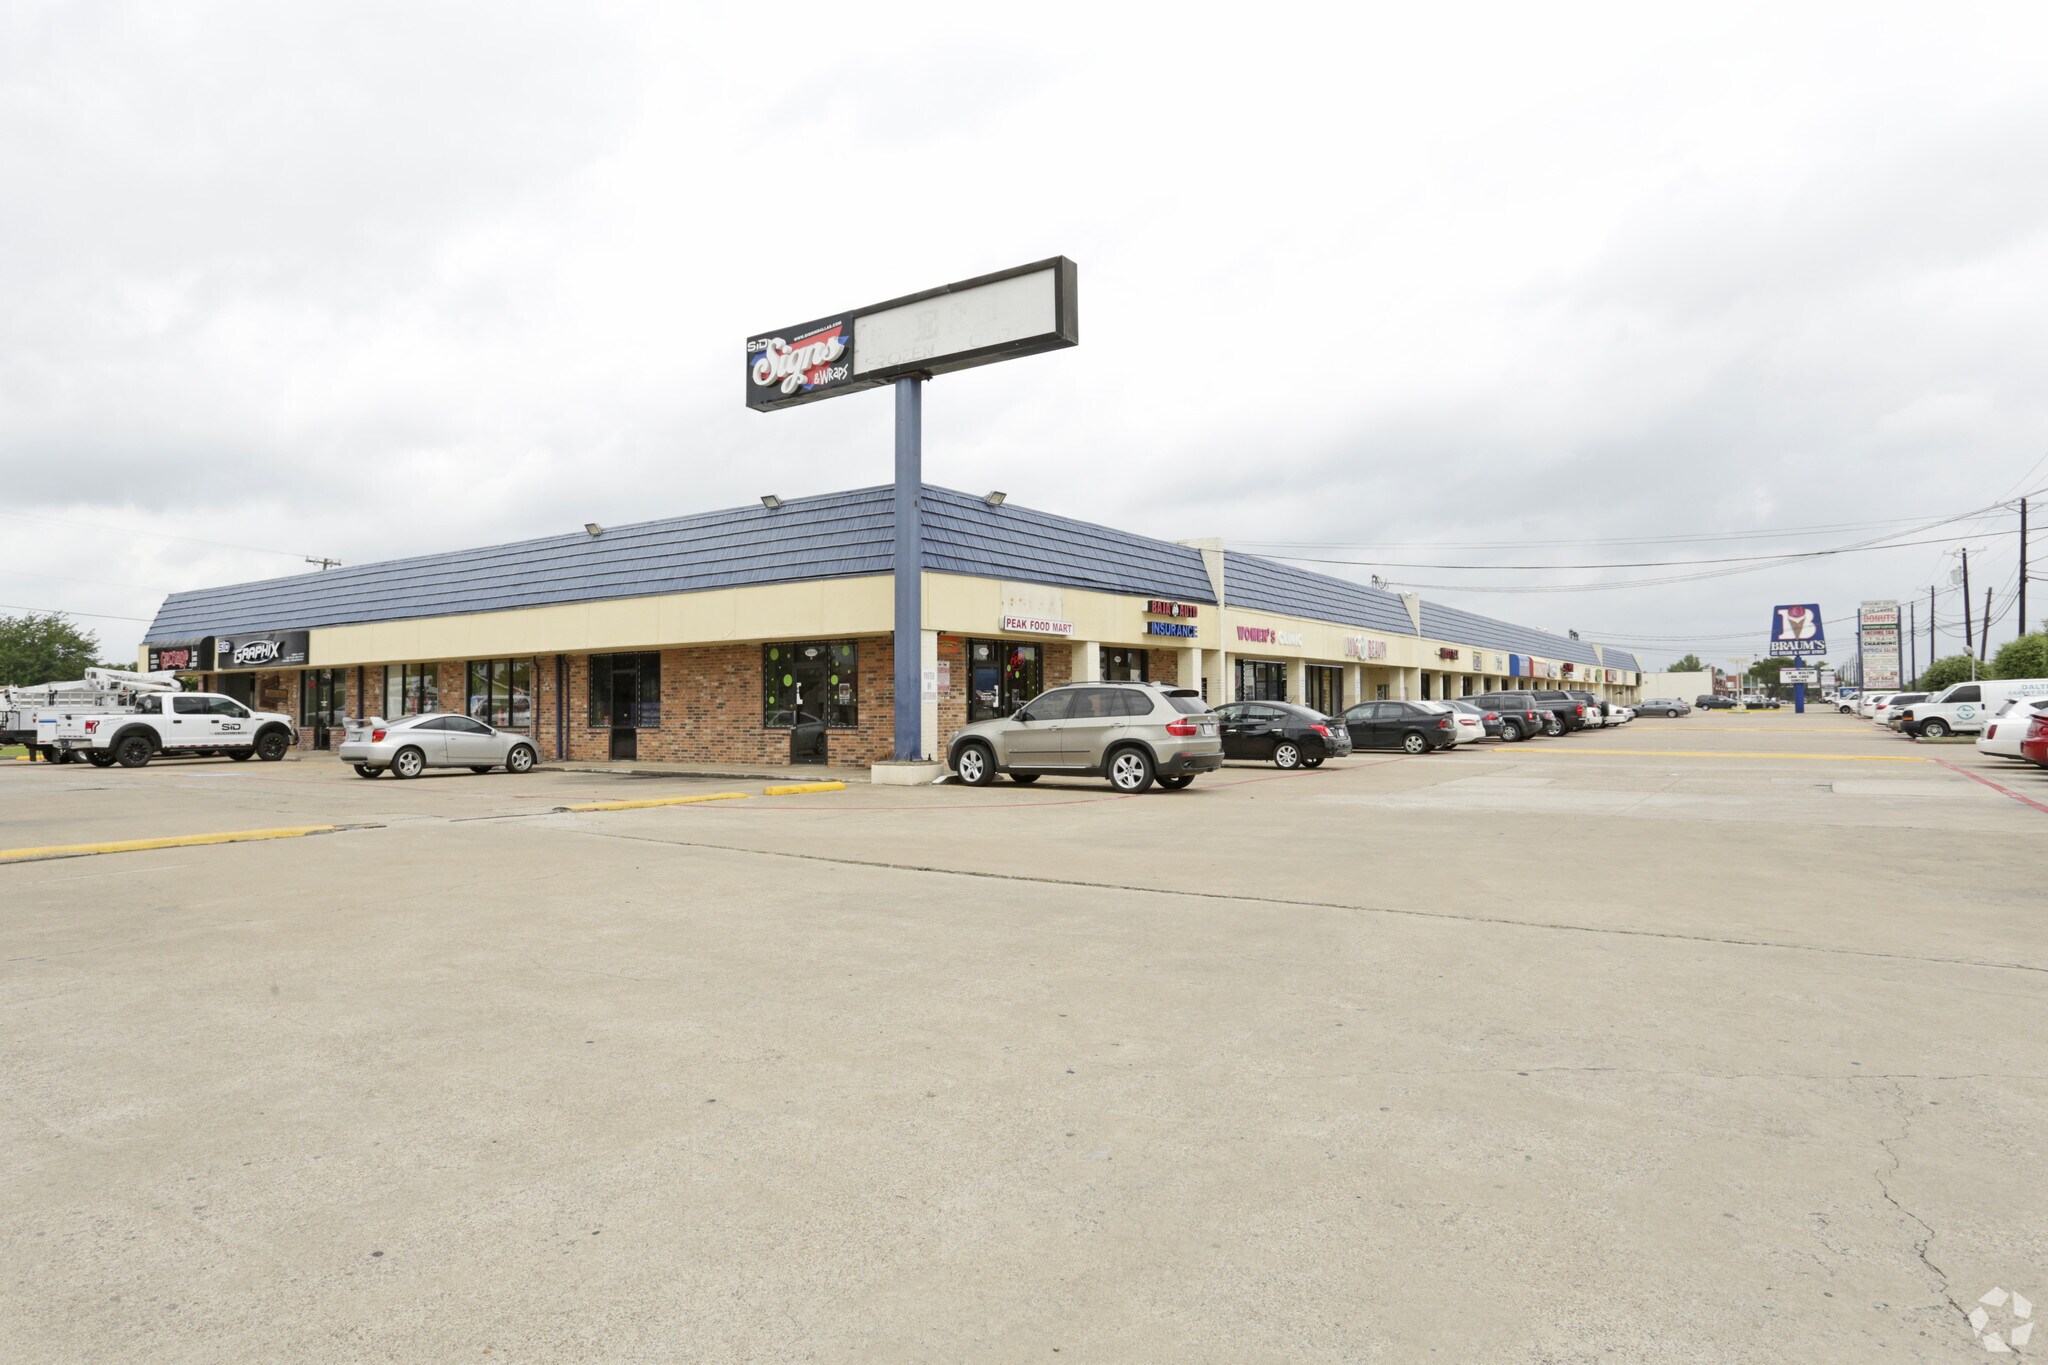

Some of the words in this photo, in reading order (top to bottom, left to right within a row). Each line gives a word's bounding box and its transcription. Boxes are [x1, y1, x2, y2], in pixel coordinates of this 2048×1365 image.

[752, 336, 844, 394] Signs
[1151, 601, 1170, 615] BAJA
[1179, 606, 1198, 617] AUTO
[1006, 618, 1027, 630] PEAK
[1030, 620, 1050, 631] FOOD
[1052, 623, 1072, 633] MART
[1864, 614, 1896, 622] DONUTS
[1151, 622, 1198, 638] INSURANCE
[1237, 626, 1276, 644] WOMEN'S
[1771, 640, 1825, 650] BRAUM'S
